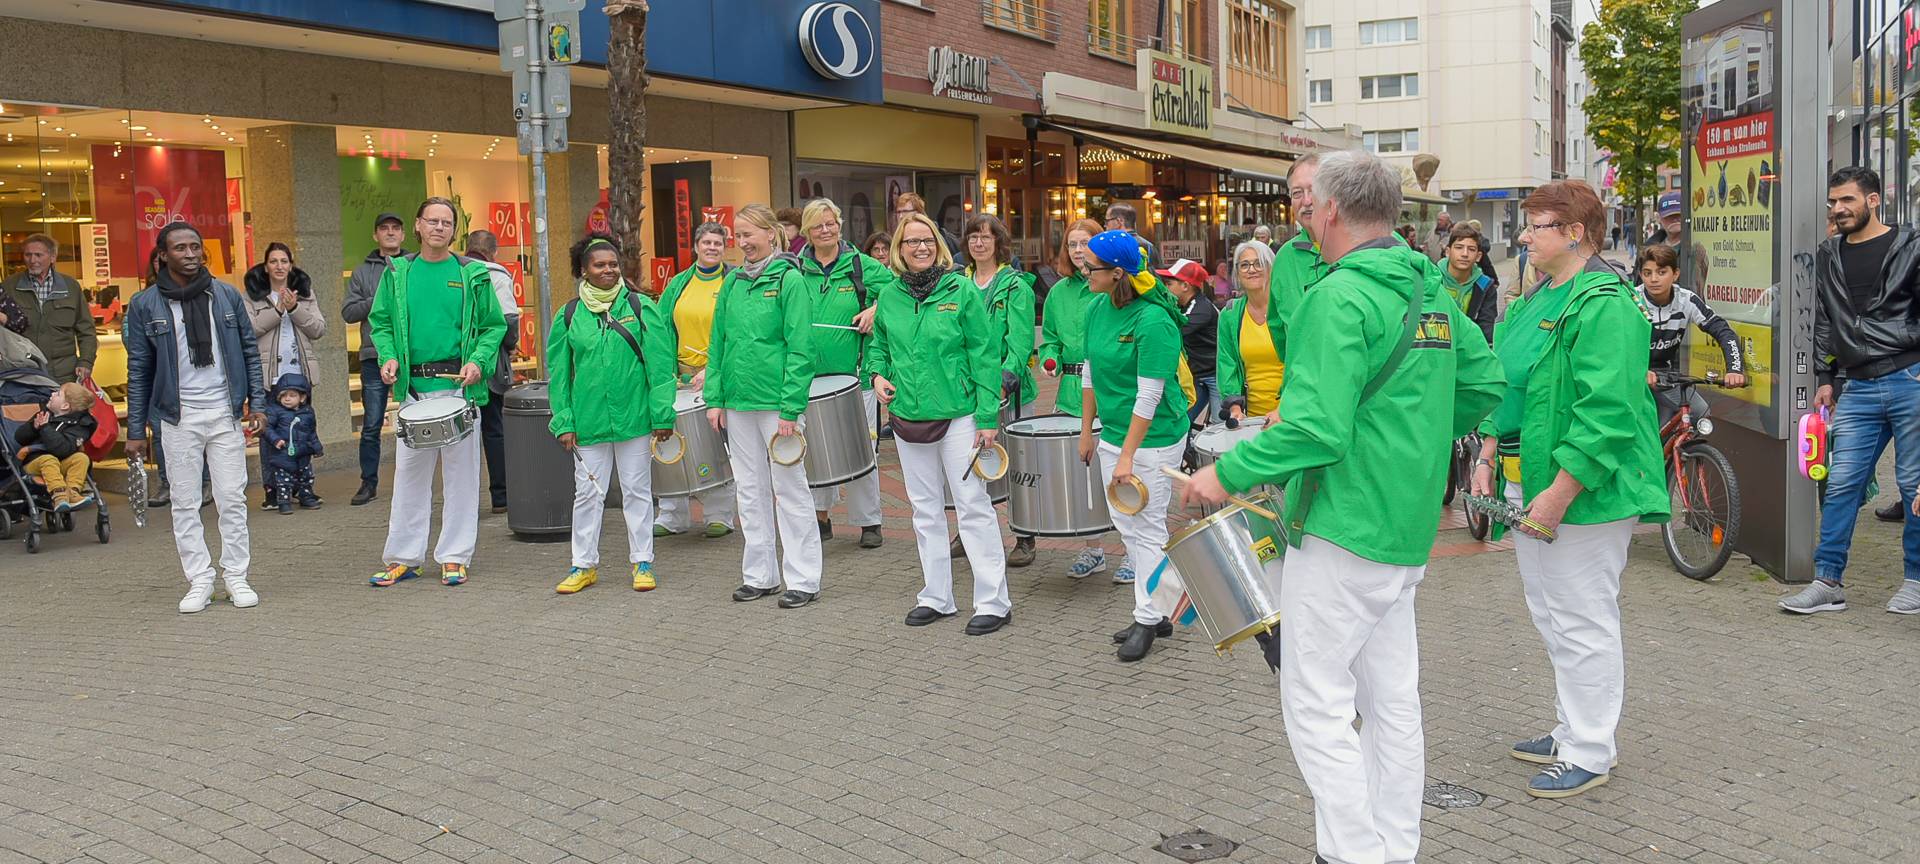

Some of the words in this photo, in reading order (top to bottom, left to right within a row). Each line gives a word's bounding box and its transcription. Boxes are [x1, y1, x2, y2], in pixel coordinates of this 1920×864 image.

[1152, 66, 1210, 130] extrablatt
[1706, 127, 1720, 144] 150
[1723, 128, 1731, 142] m
[1733, 124, 1748, 140] von
[1750, 119, 1768, 138] hier
[145, 210, 185, 229] sale
[1693, 216, 1719, 232] ANKAUF
[1722, 216, 1728, 232] &
[1730, 214, 1769, 231] BELEIHUNG
[1713, 241, 1721, 251] von
[93, 226, 110, 286] LONDON
[1712, 256, 1727, 268] Uhren
[1707, 284, 1738, 302] BARGELD
[1727, 339, 1741, 371] Rabobank
